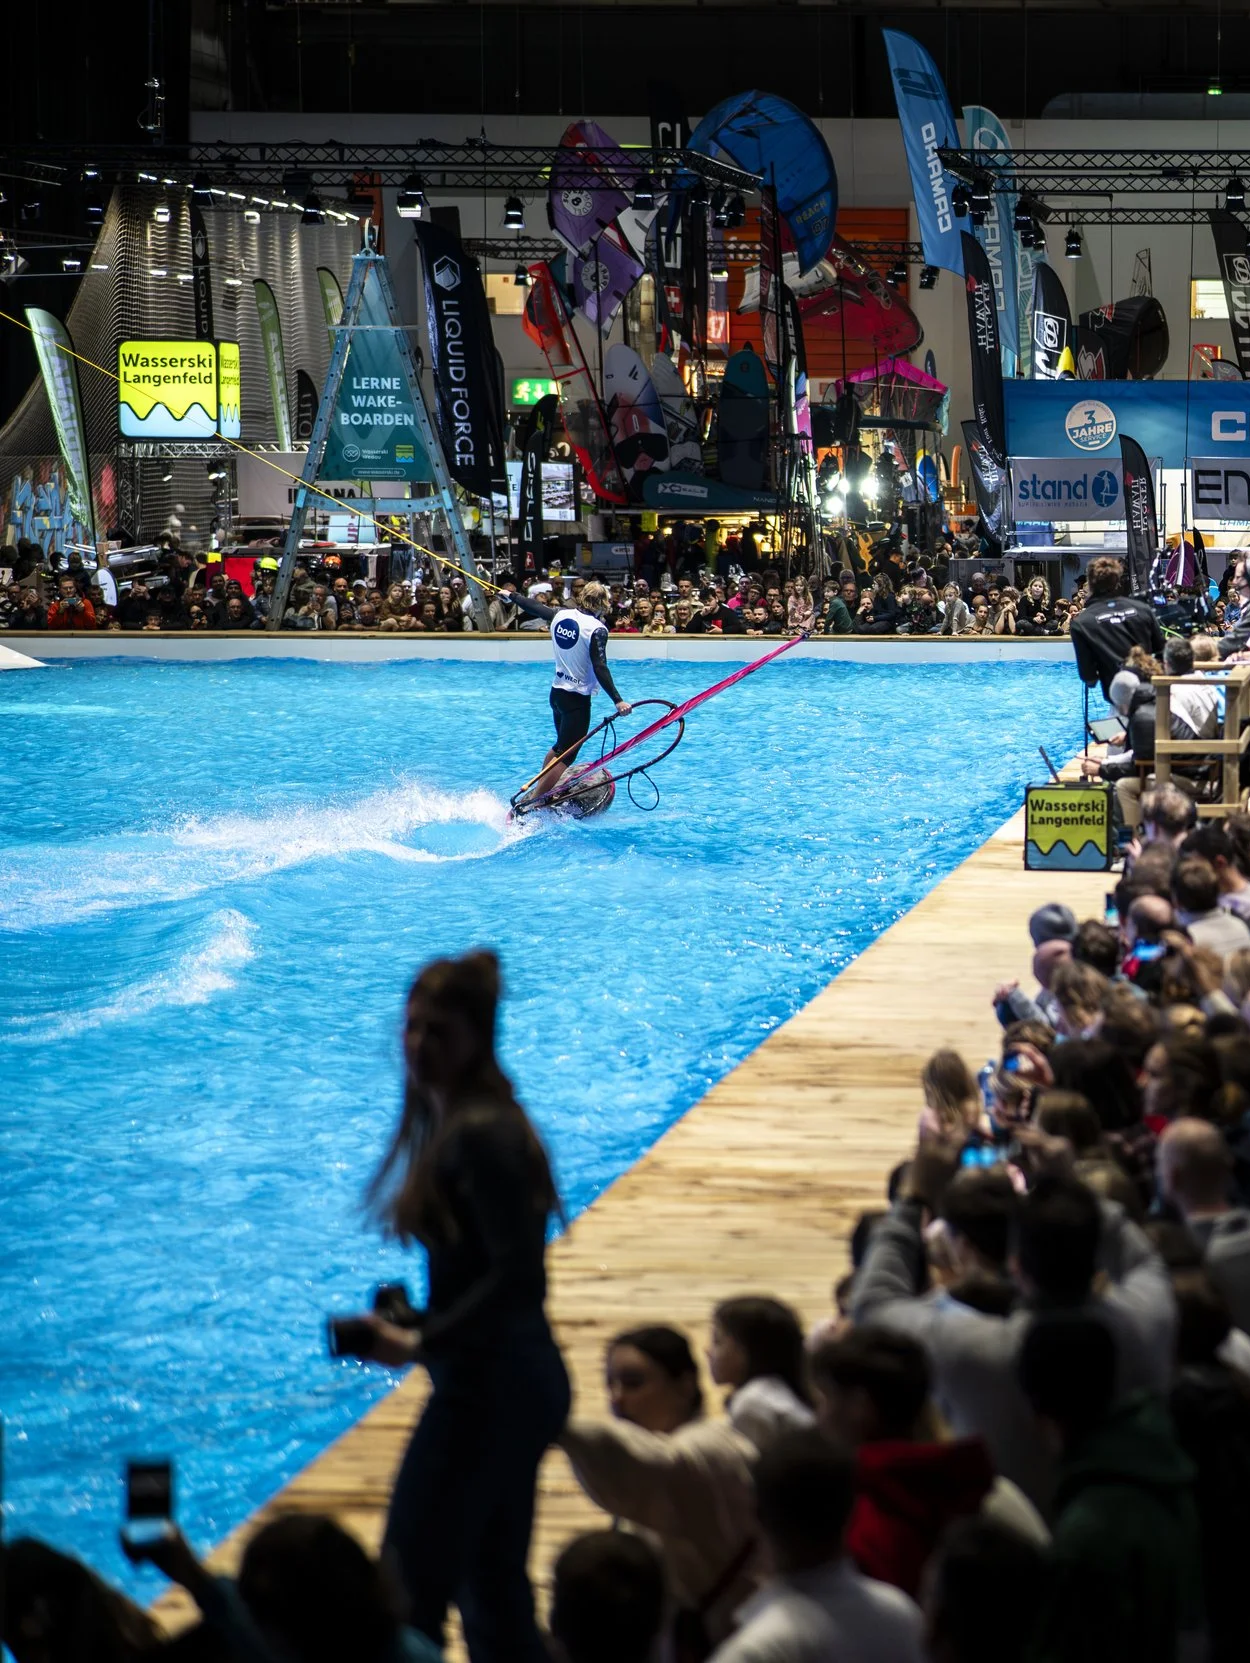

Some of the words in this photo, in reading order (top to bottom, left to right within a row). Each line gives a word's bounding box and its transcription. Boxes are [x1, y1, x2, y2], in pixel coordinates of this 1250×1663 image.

[442, 300, 467, 387] LIQUID
[122, 354, 213, 369] Wasserski
[122, 371, 213, 387] Langenfeld
[352, 377, 401, 390] LERNE
[351, 395, 403, 408] WAKE-
[340, 413, 415, 426] BOARDEN
[1084, 410, 1096, 425] 3
[451, 387, 475, 467] FORCE
[1072, 422, 1113, 439] JAHRE
[1079, 433, 1107, 443] SERVICE
[1018, 473, 1088, 500] stand
[556, 624, 577, 640] boot
[1029, 799, 1105, 813] Wasserski
[1029, 814, 1105, 828] Langenfeld
